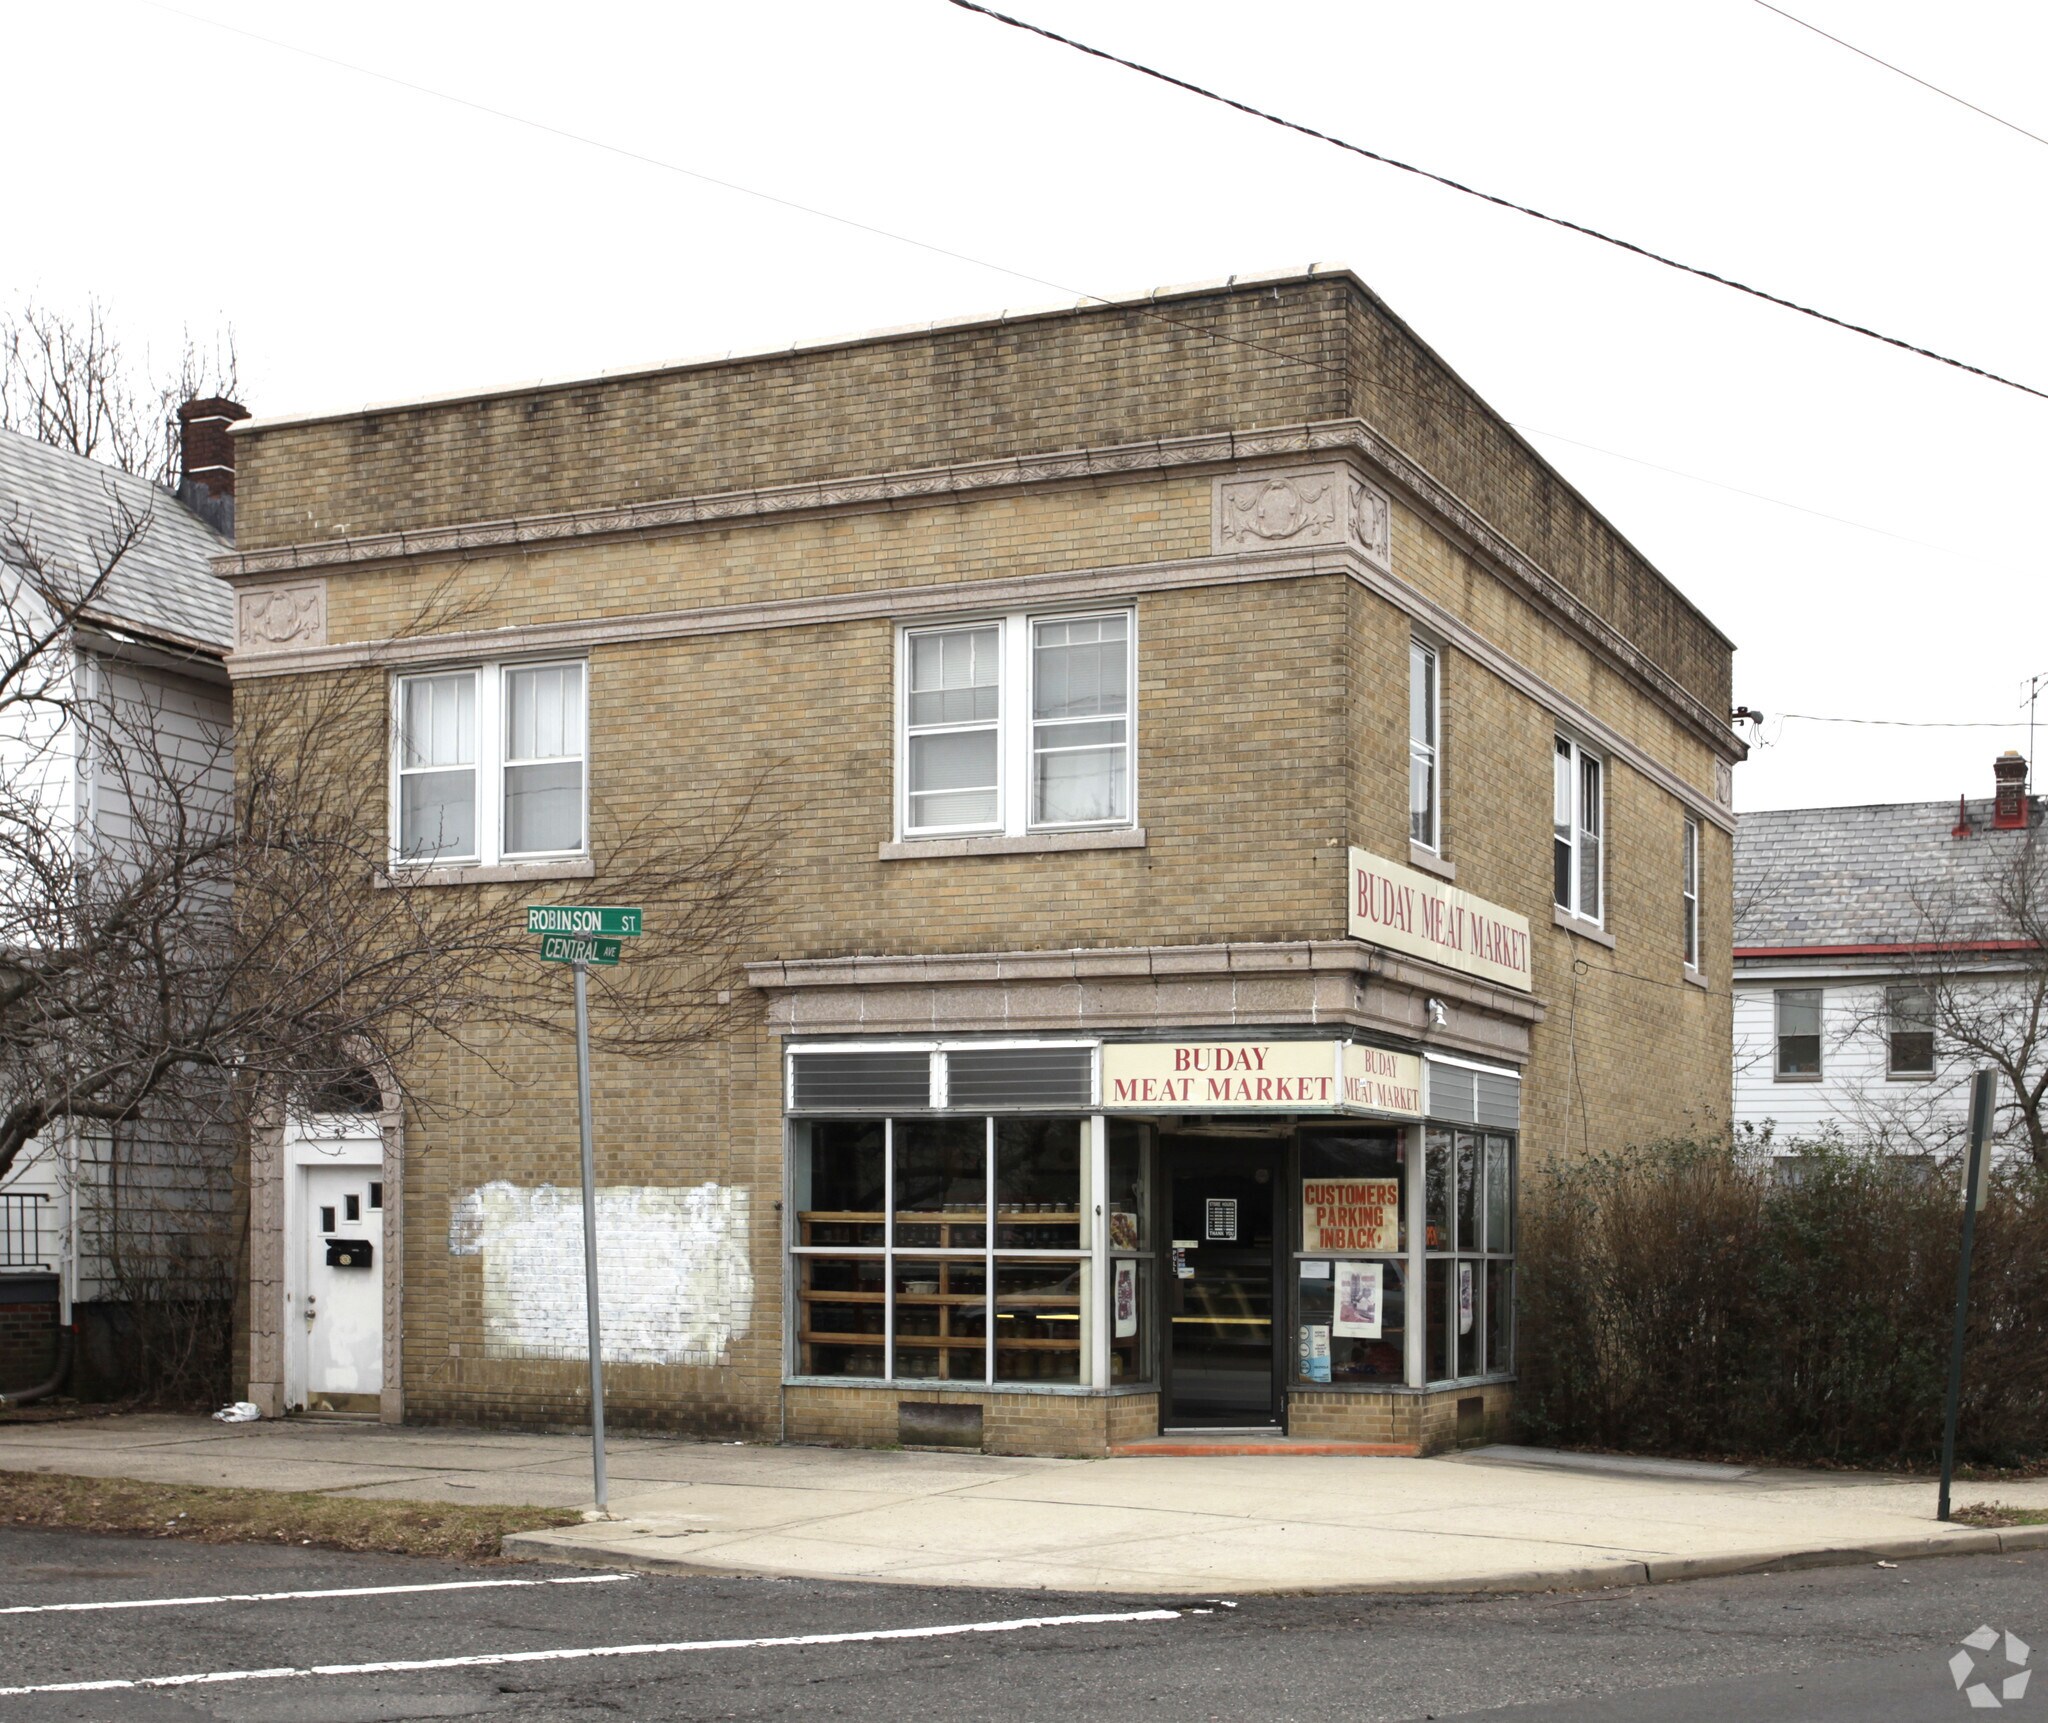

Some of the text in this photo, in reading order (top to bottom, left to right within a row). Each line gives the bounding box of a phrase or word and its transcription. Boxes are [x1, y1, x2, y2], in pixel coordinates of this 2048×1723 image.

[528, 909, 636, 932] ROBINSON ST
[1356, 868, 1527, 973] BUDAY MEAT MARKET
[545, 937, 617, 961] CENTRAL AVE
[1173, 1046, 1270, 1072] BUDAY
[1364, 1049, 1398, 1078] BUDAY
[1112, 1076, 1333, 1102] MEAT MARKET
[1344, 1075, 1418, 1111] MEAT MARKET
[1304, 1184, 1397, 1206] CUSTOMERS
[1316, 1206, 1384, 1227] PARKING
[1319, 1228, 1377, 1249] IN BACK
